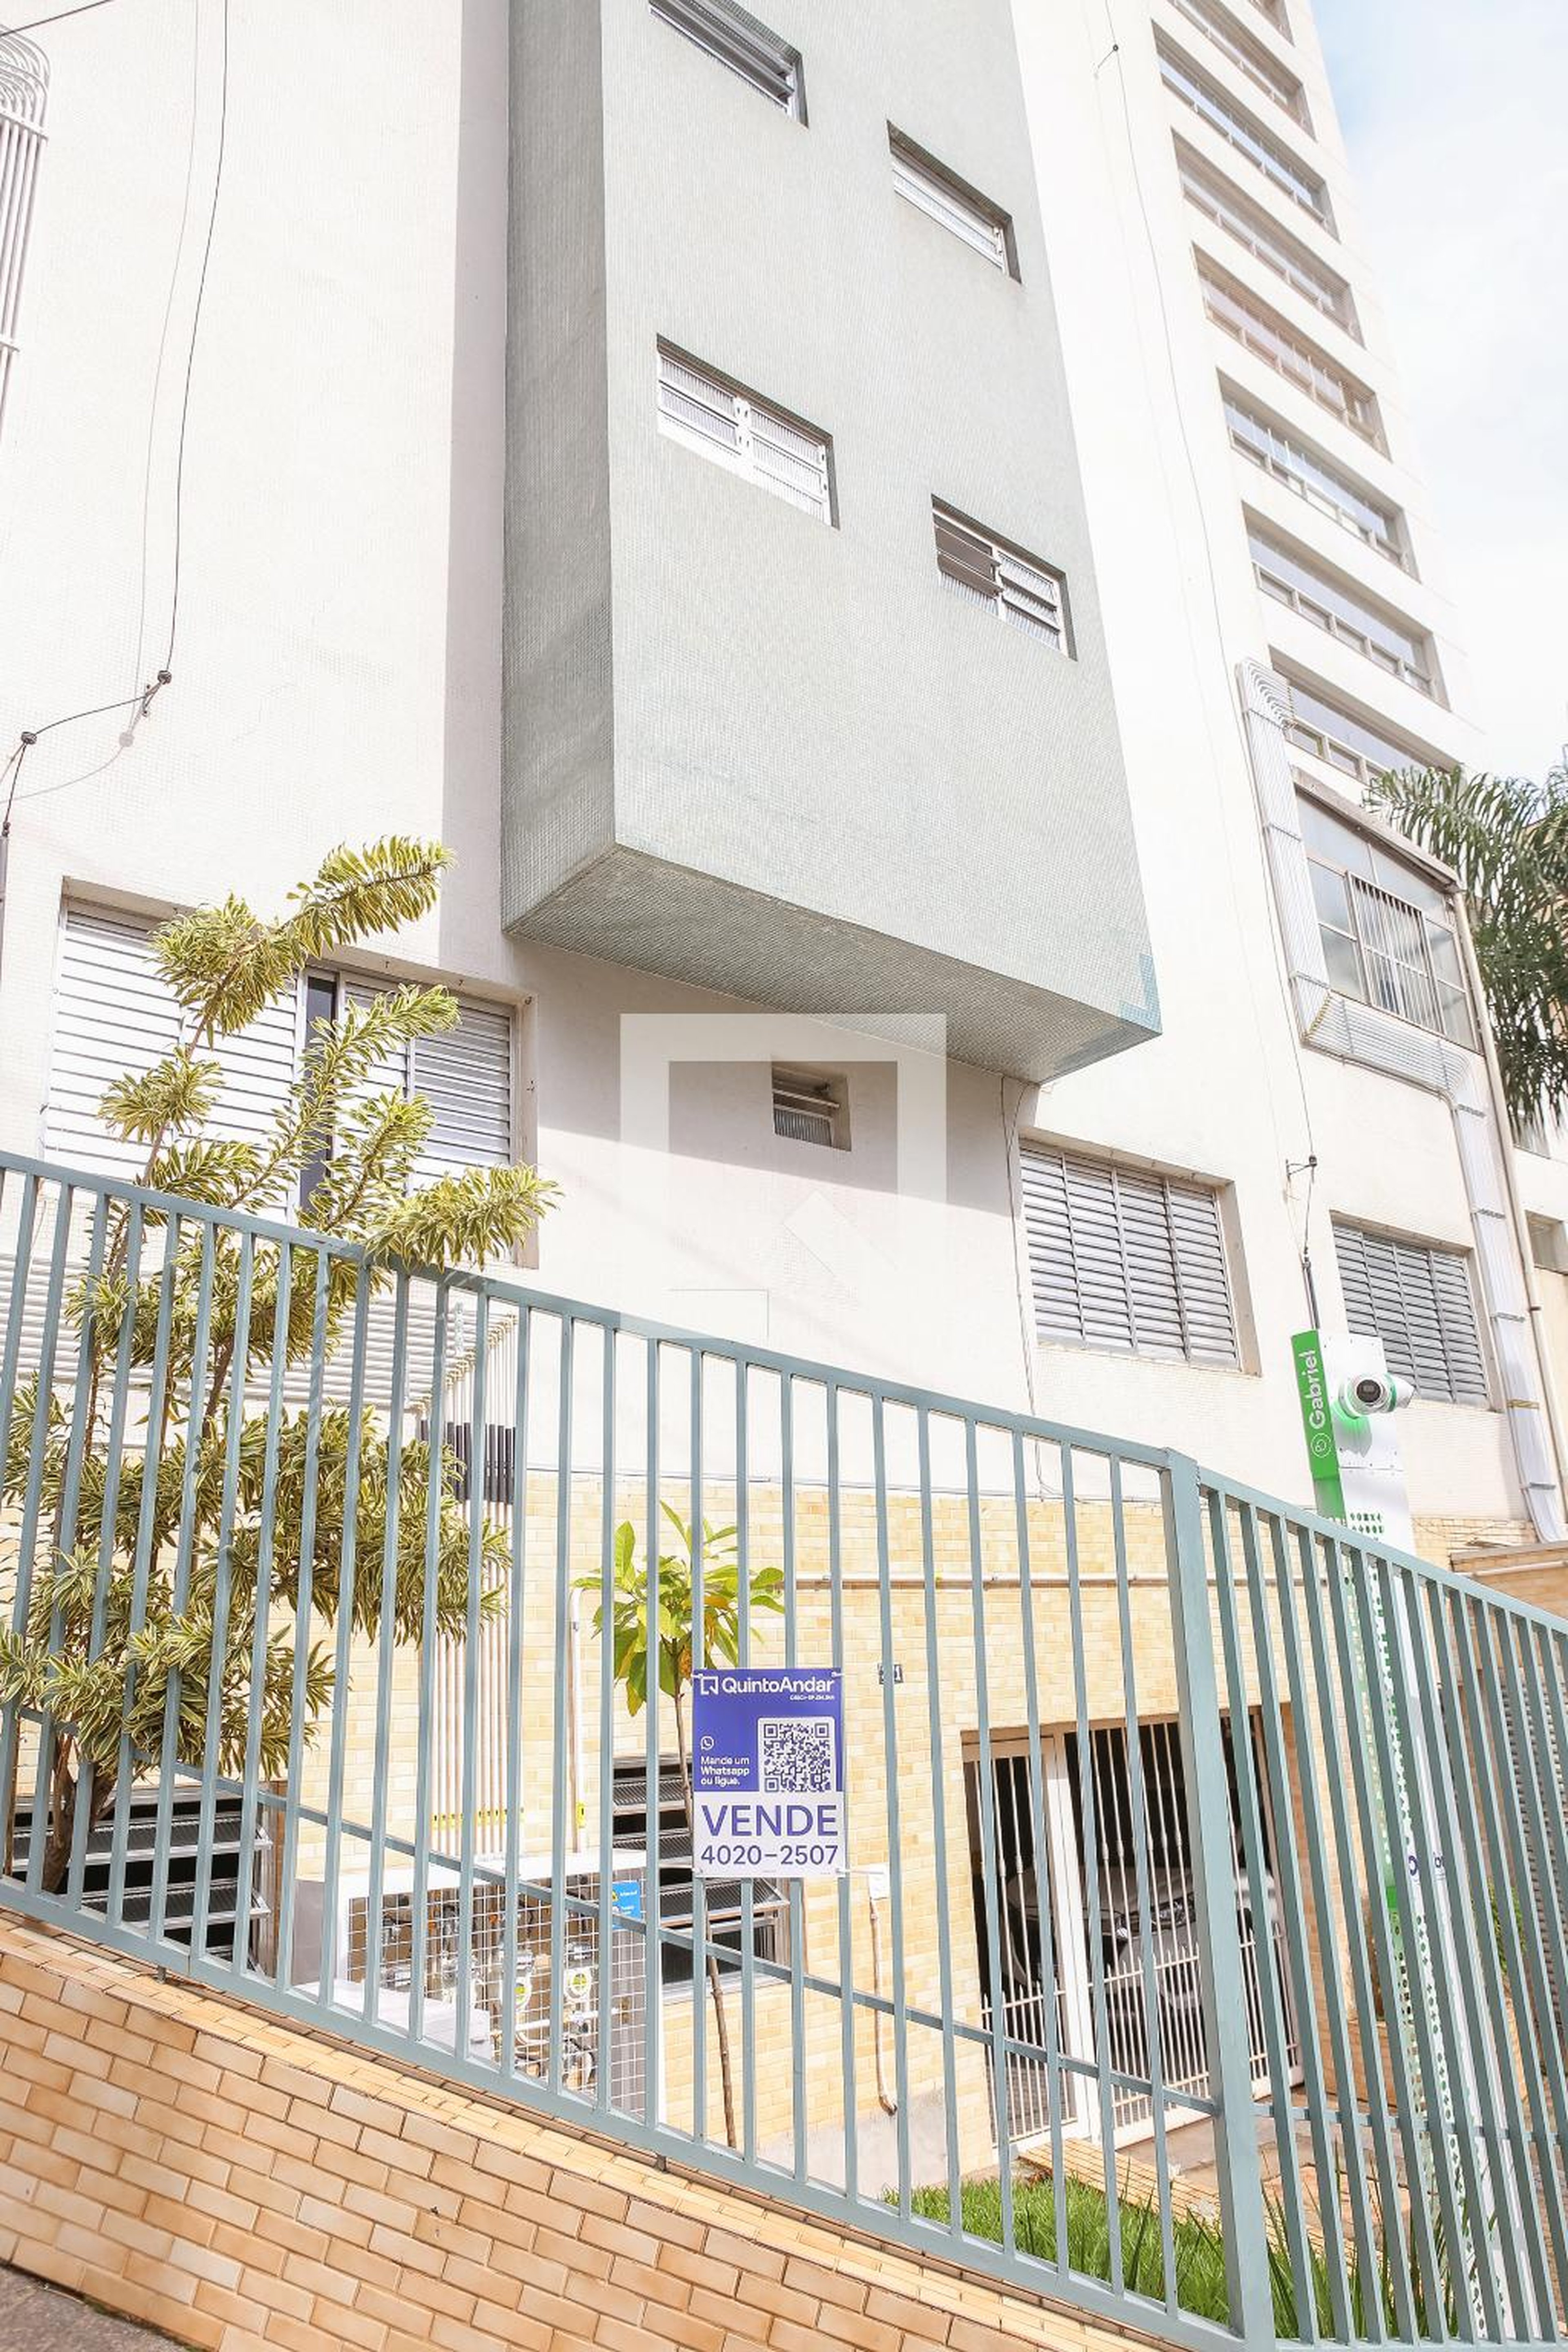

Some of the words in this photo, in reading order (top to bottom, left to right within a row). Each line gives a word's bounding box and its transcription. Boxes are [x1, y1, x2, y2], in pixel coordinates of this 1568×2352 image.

[1298, 1350, 1326, 1429] Gabriel
[722, 1676, 835, 1694] QuintoAndar
[701, 1756, 733, 1764] Mande
[701, 1805, 838, 1837] VENDE
[701, 1844, 838, 1865] 4020-2507
